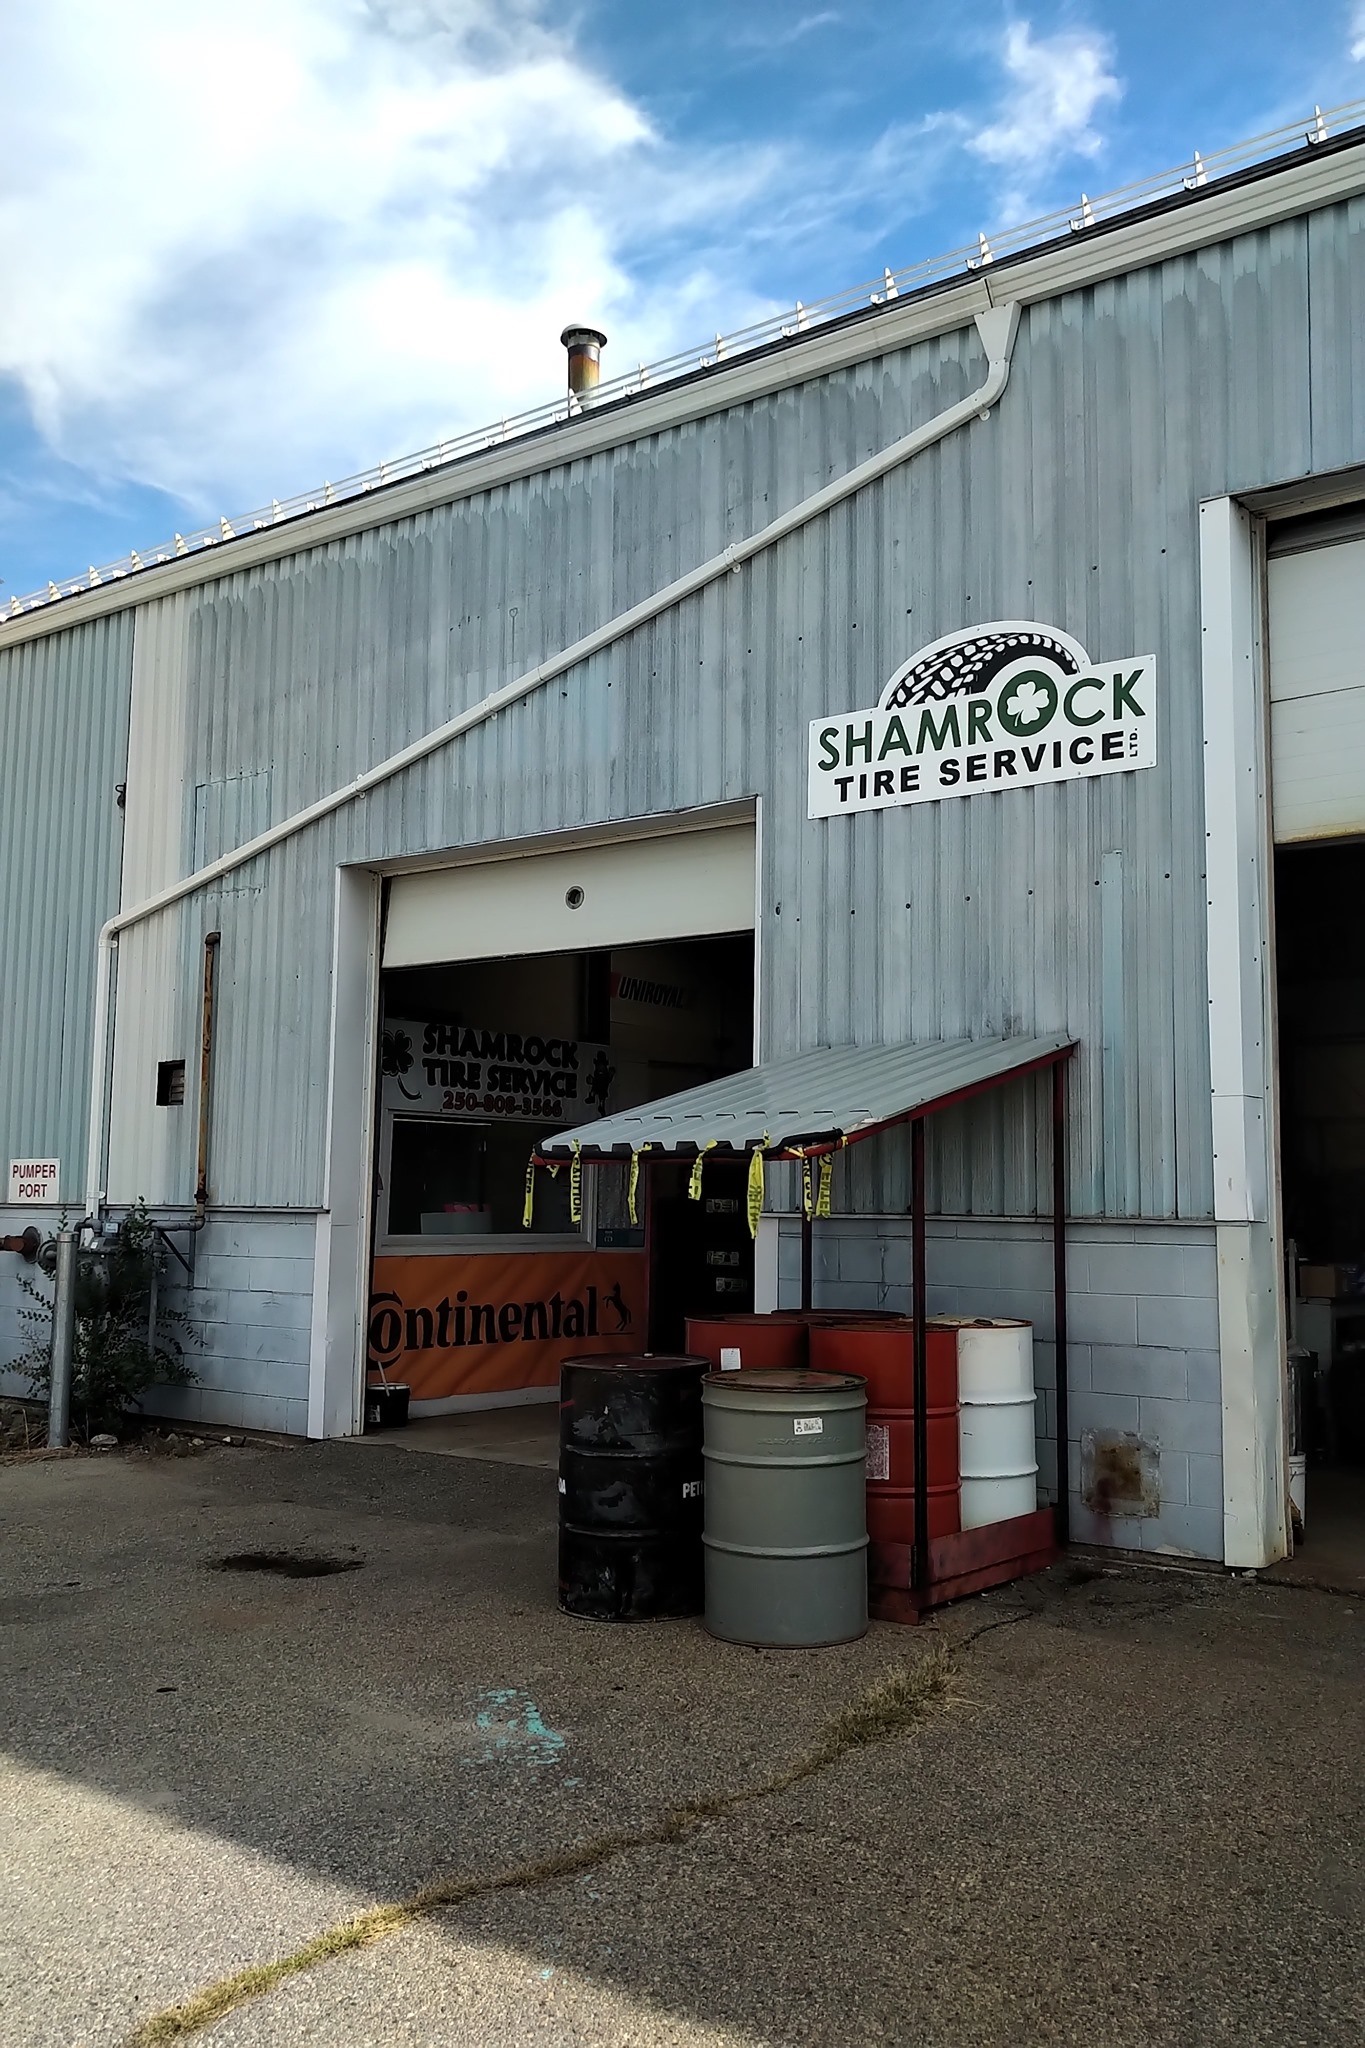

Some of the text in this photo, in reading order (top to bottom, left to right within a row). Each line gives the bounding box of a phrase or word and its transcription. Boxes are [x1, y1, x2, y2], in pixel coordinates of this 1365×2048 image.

[817, 668, 1146, 772] SHAMROCK
[834, 727, 1138, 802] TIRE SERVICE LTD.
[618, 976, 683, 1009] UNIROYAL
[422, 1023, 579, 1070] SHAMROCK
[422, 1057, 578, 1099] TIRE SERVICE
[12, 1164, 56, 1178] PUMPER
[18, 1183, 47, 1197] PORT
